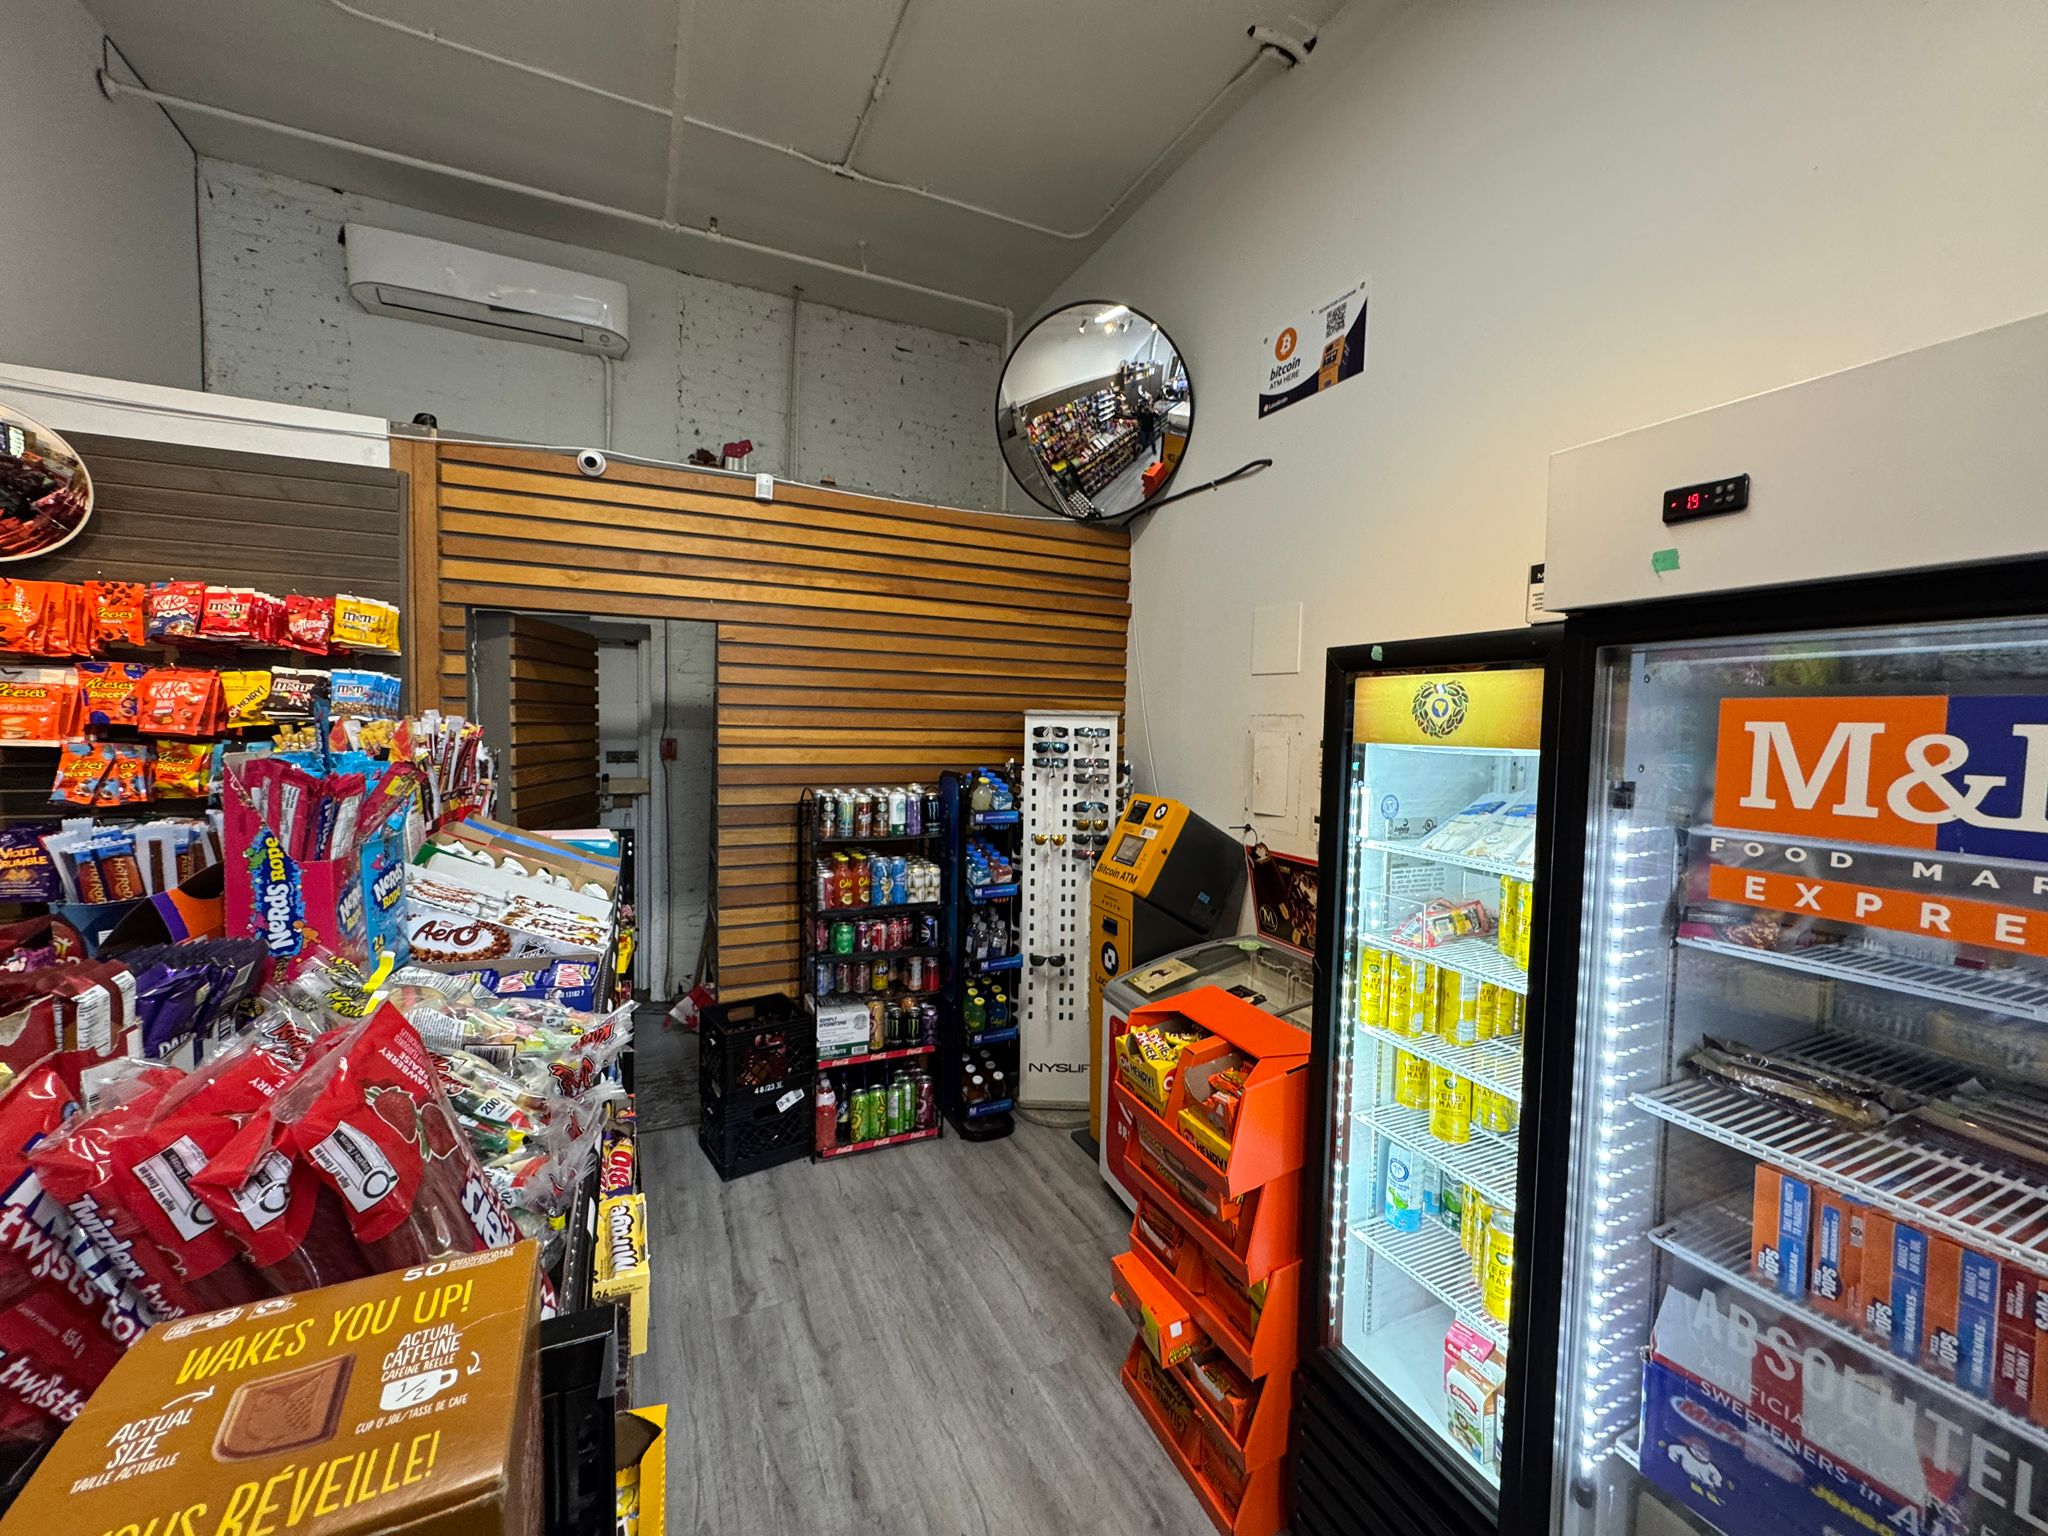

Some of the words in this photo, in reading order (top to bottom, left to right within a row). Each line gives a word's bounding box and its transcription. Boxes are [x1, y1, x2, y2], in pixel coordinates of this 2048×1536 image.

[1270, 357, 1300, 381] bitcoin
[1270, 378, 1282, 390] ATM
[1284, 370, 1300, 384] HERE
[228, 704, 241, 719] OH
[238, 685, 268, 712] HENRY!
[1710, 838, 1853, 869] FOOD
[1096, 863, 1120, 878] Bitcoin
[1120, 872, 1138, 886] ATM
[1744, 876, 2028, 945] EXPRE
[1136, 1032, 1150, 1046] OH
[378, 1045, 438, 1096] TRAWBERRY
[397, 1051, 430, 1079] FRAISE
[1120, 1056, 1133, 1074] OH
[1131, 1064, 1156, 1093] HENRY!
[479, 1097, 501, 1116] 200
[1197, 1144, 1228, 1172] HENRY!
[160, 1195, 177, 1213] High
[68, 1192, 146, 1281] Twizzlers
[610, 1204, 638, 1272] Mirage
[402, 1262, 448, 1282] 50
[1821, 1264, 1837, 1300] POPS
[176, 1318, 312, 1386] WAKES
[328, 1296, 400, 1347] YOU
[414, 1278, 474, 1326] UP!
[398, 1322, 456, 1350] ACTUAL
[382, 1332, 464, 1370] CAFFEINE
[0, 1356, 85, 1422] twists
[396, 1379, 428, 1402] 1/2
[106, 1408, 194, 1447] ACTUAL
[355, 1420, 374, 1435] CUP
[435, 1400, 446, 1412] DE
[1700, 1380, 1849, 1484] SWEETENERS
[106, 1434, 160, 1469] SIZE
[70, 1470, 115, 1495] TAILLE
[118, 1453, 180, 1482] ACTUELLE
[224, 1430, 438, 1536] RÉVEILLE!
